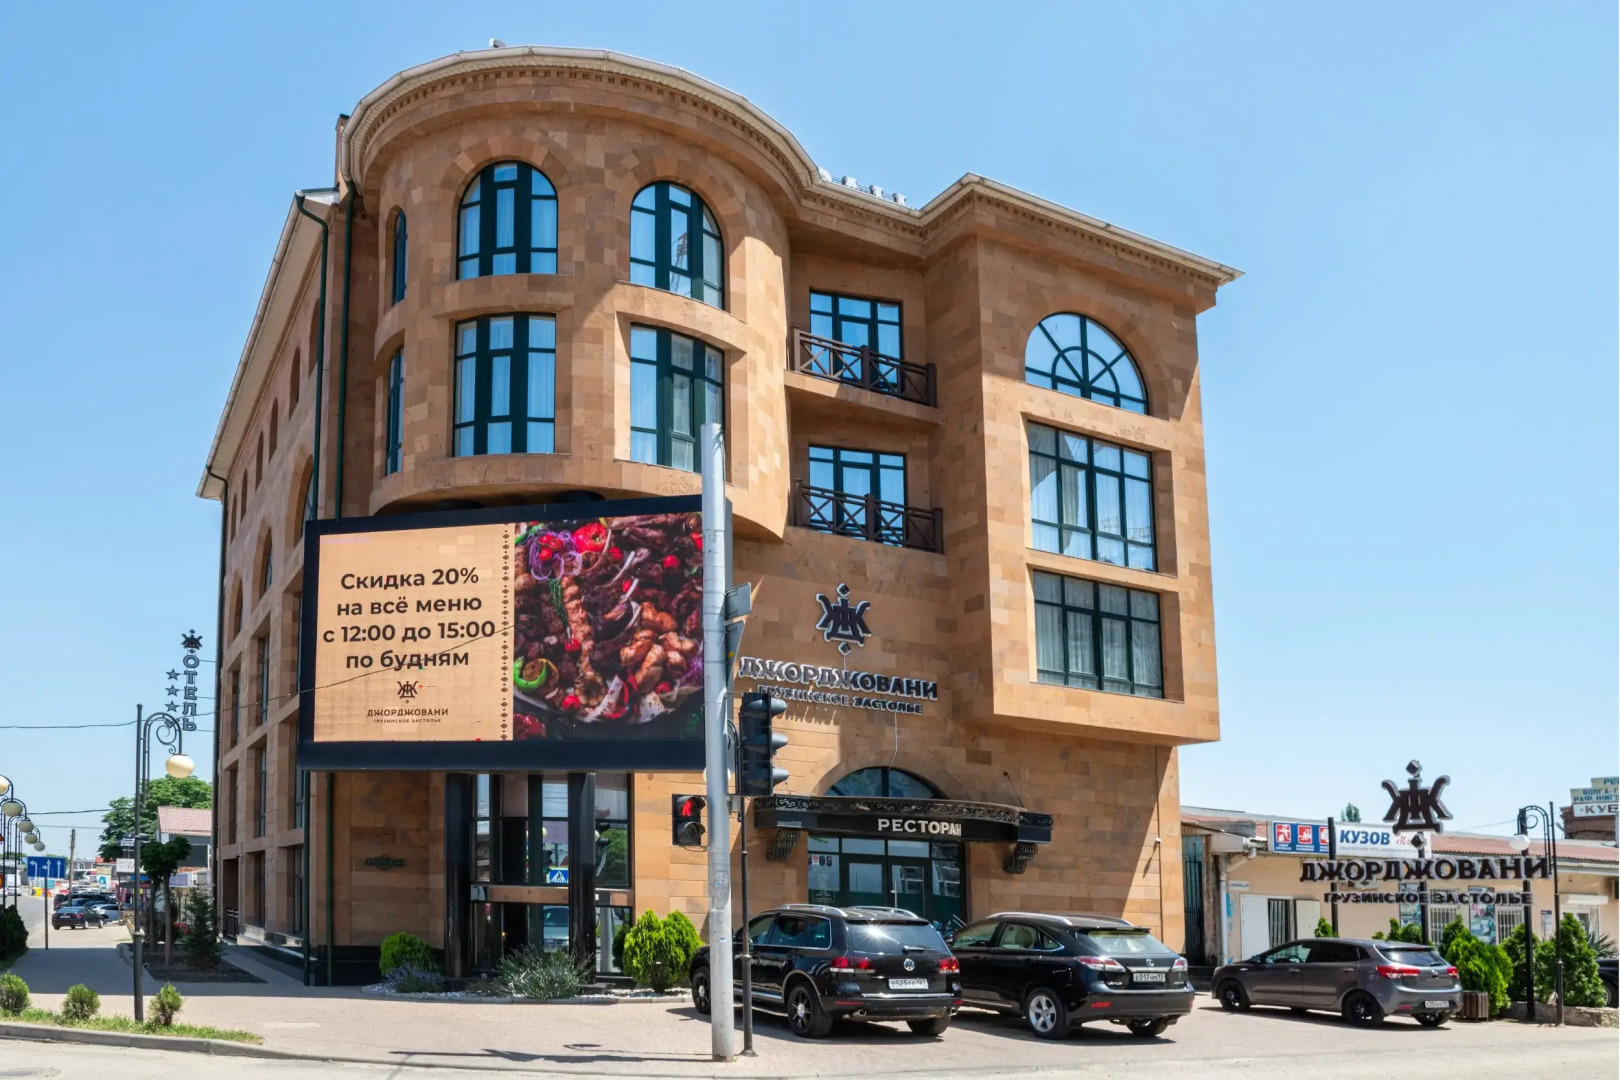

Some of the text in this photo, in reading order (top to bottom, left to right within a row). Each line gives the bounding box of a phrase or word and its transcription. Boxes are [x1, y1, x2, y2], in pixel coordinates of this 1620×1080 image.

[341, 567, 479, 590] Скидка 20%
[337, 596, 482, 616] на всё меню
[323, 620, 496, 643] с 12:00 до 15:00
[346, 650, 469, 671] по будням
[738, 656, 938, 700] ДЖОРДЖОВАНИ
[182, 654, 200, 731] ОТЕЛЬ
[757, 685, 923, 716] ГРУЗИНСКОЕ ЗАСТОЛЬЕ
[367, 708, 449, 717] ДЖОРДЖОВАНИ
[877, 818, 962, 836] РЕСТОРАН
[1339, 829, 1391, 845] КУЗОВ
[1299, 856, 1552, 883] ДЖОРДЖОВАНИ
[1324, 890, 1533, 906] ГРУЗИНСКОЕ ЗАСТОЛЬЕ
